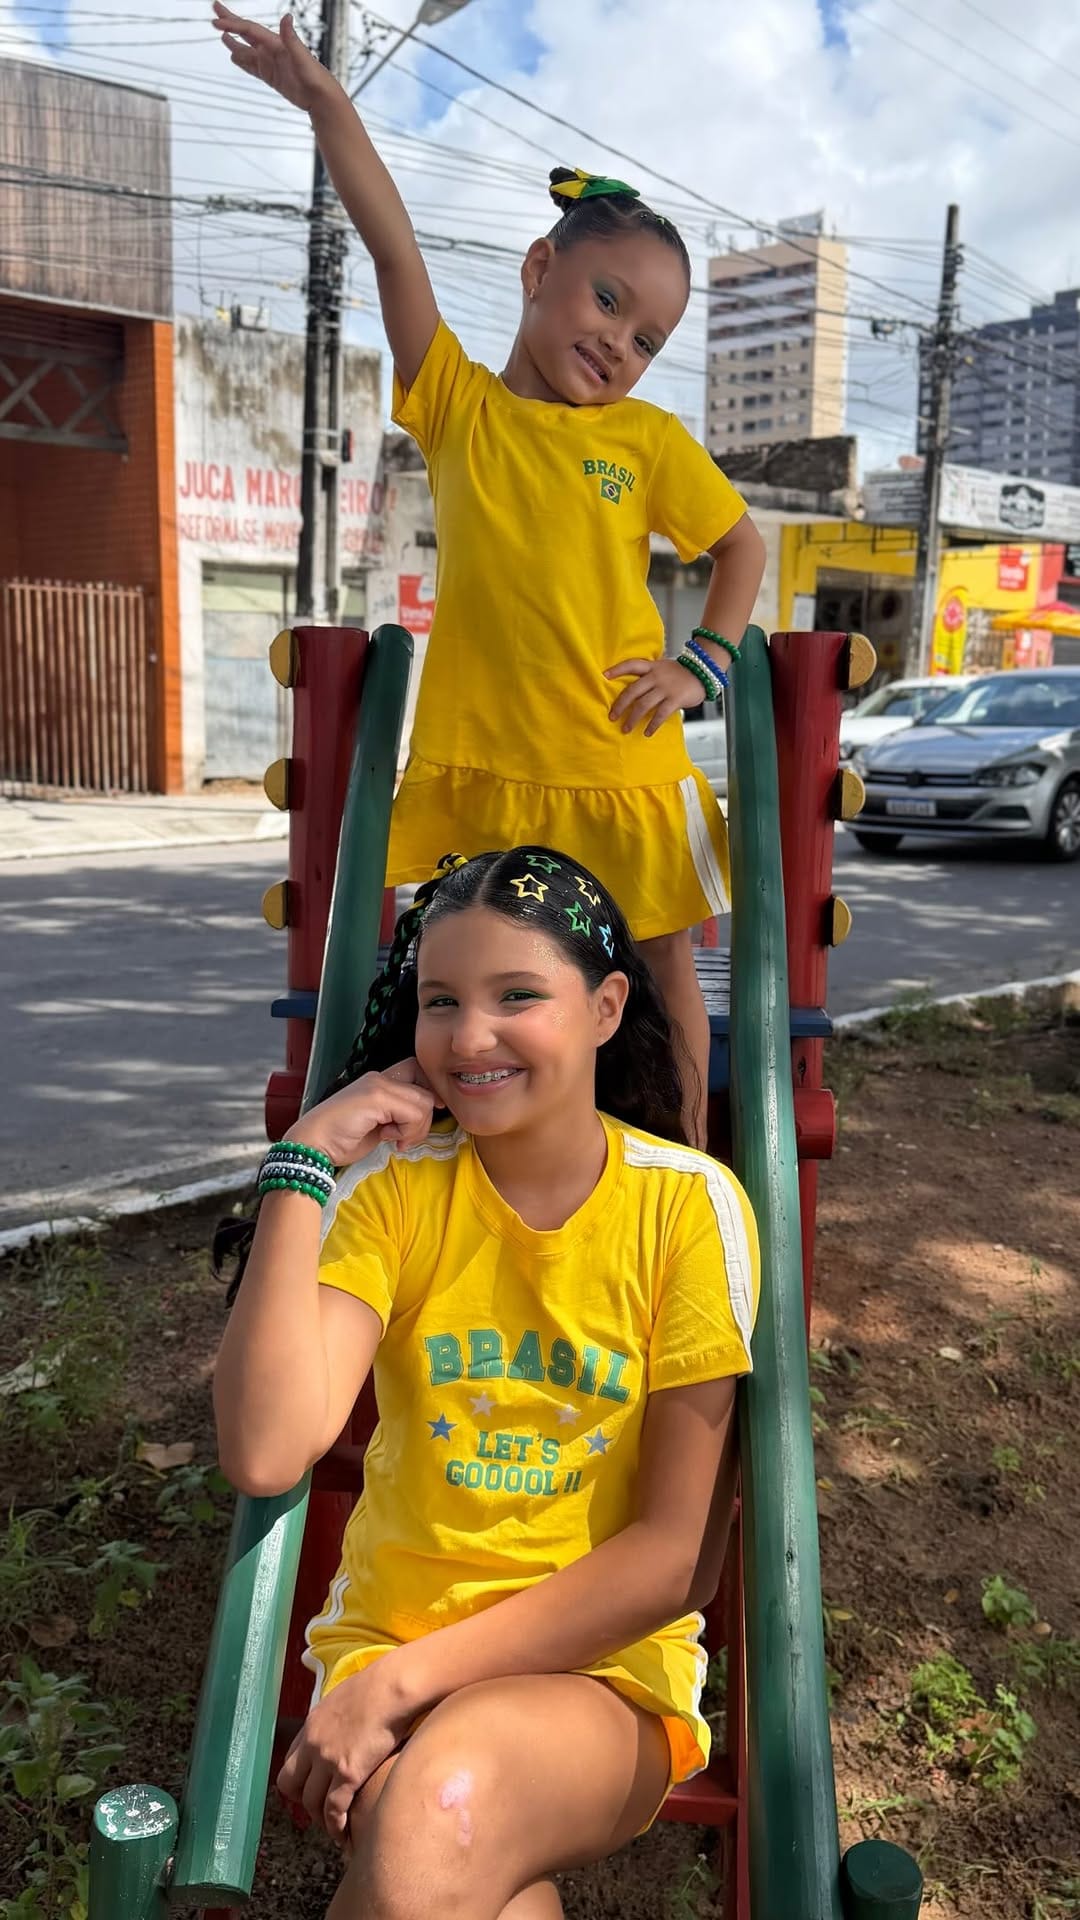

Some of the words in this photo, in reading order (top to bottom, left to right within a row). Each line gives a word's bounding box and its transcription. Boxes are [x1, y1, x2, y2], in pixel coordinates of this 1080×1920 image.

[179, 460, 236, 503] JUCA
[582, 459, 636, 492] BRASIL
[424, 1328, 631, 1404] BRASIL
[476, 1430, 561, 1465] LET'S
[446, 1459, 558, 1496] GOOOOL
